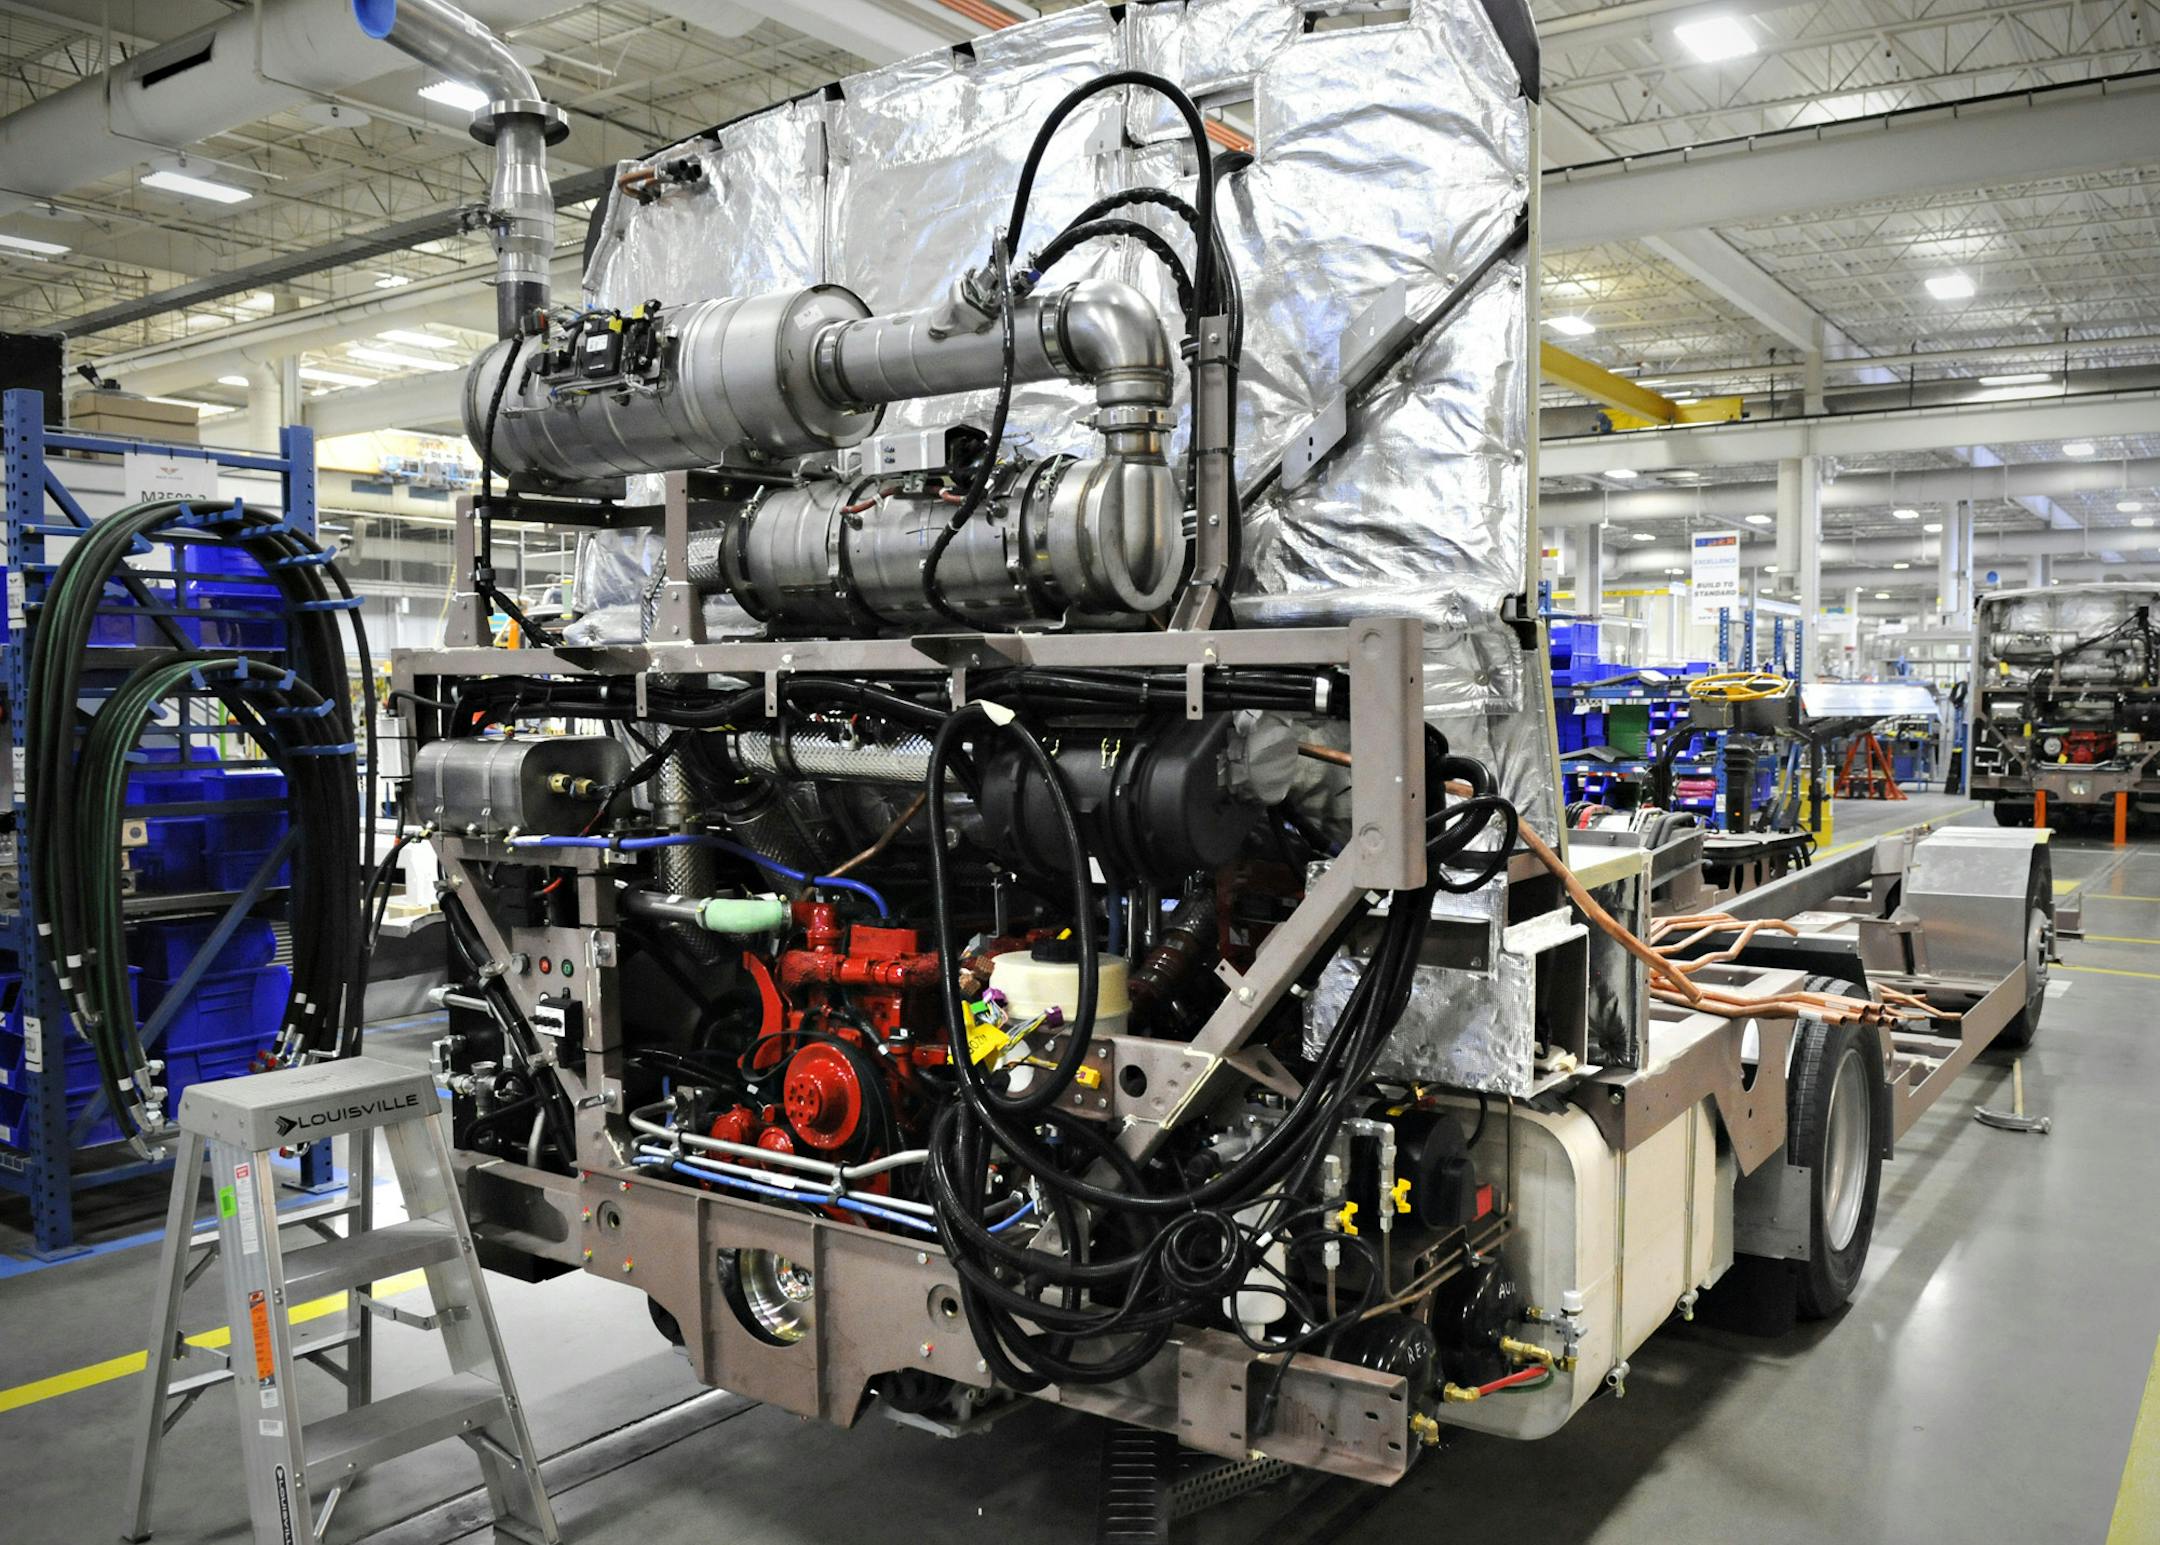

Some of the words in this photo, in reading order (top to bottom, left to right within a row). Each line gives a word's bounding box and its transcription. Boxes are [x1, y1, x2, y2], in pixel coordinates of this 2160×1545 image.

[1694, 589, 1737, 597] STANDARD
[297, 1094, 419, 1129] LOUISVILLE
[1498, 1281, 1517, 1299] AUX
[1407, 1341, 1428, 1365] RES
